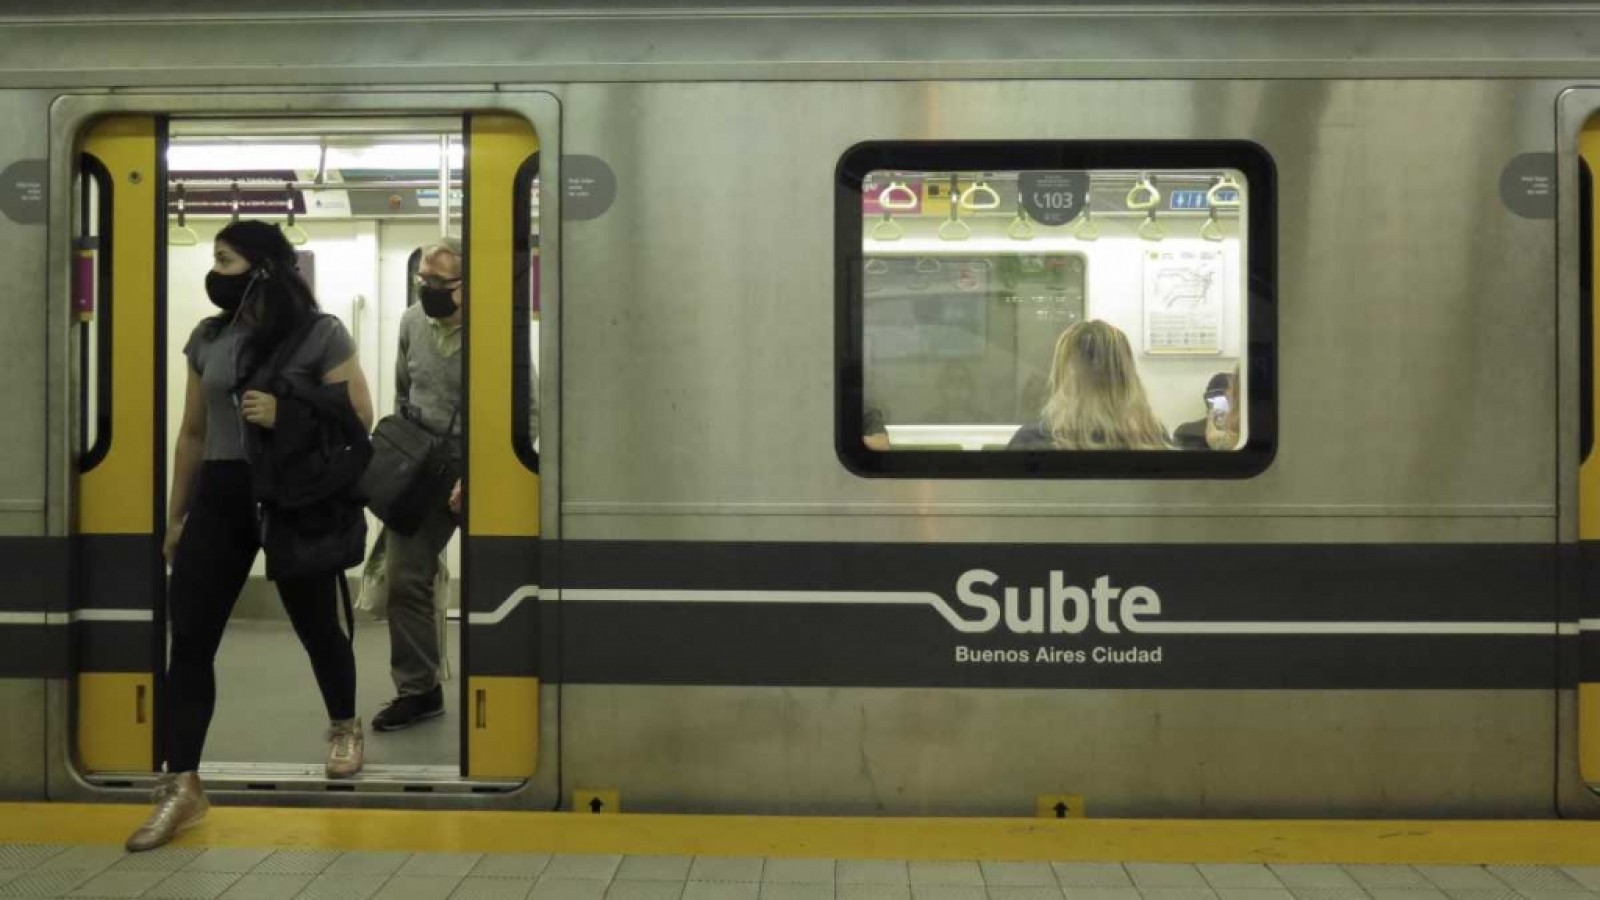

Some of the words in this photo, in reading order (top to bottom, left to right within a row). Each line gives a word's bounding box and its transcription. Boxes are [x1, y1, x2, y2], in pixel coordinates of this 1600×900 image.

[1042, 191, 1073, 209] 103
[955, 568, 1162, 634] Subte
[955, 646, 1030, 663] Buenos
[1035, 646, 1087, 663] Aires
[1091, 646, 1163, 663] Ciudad
